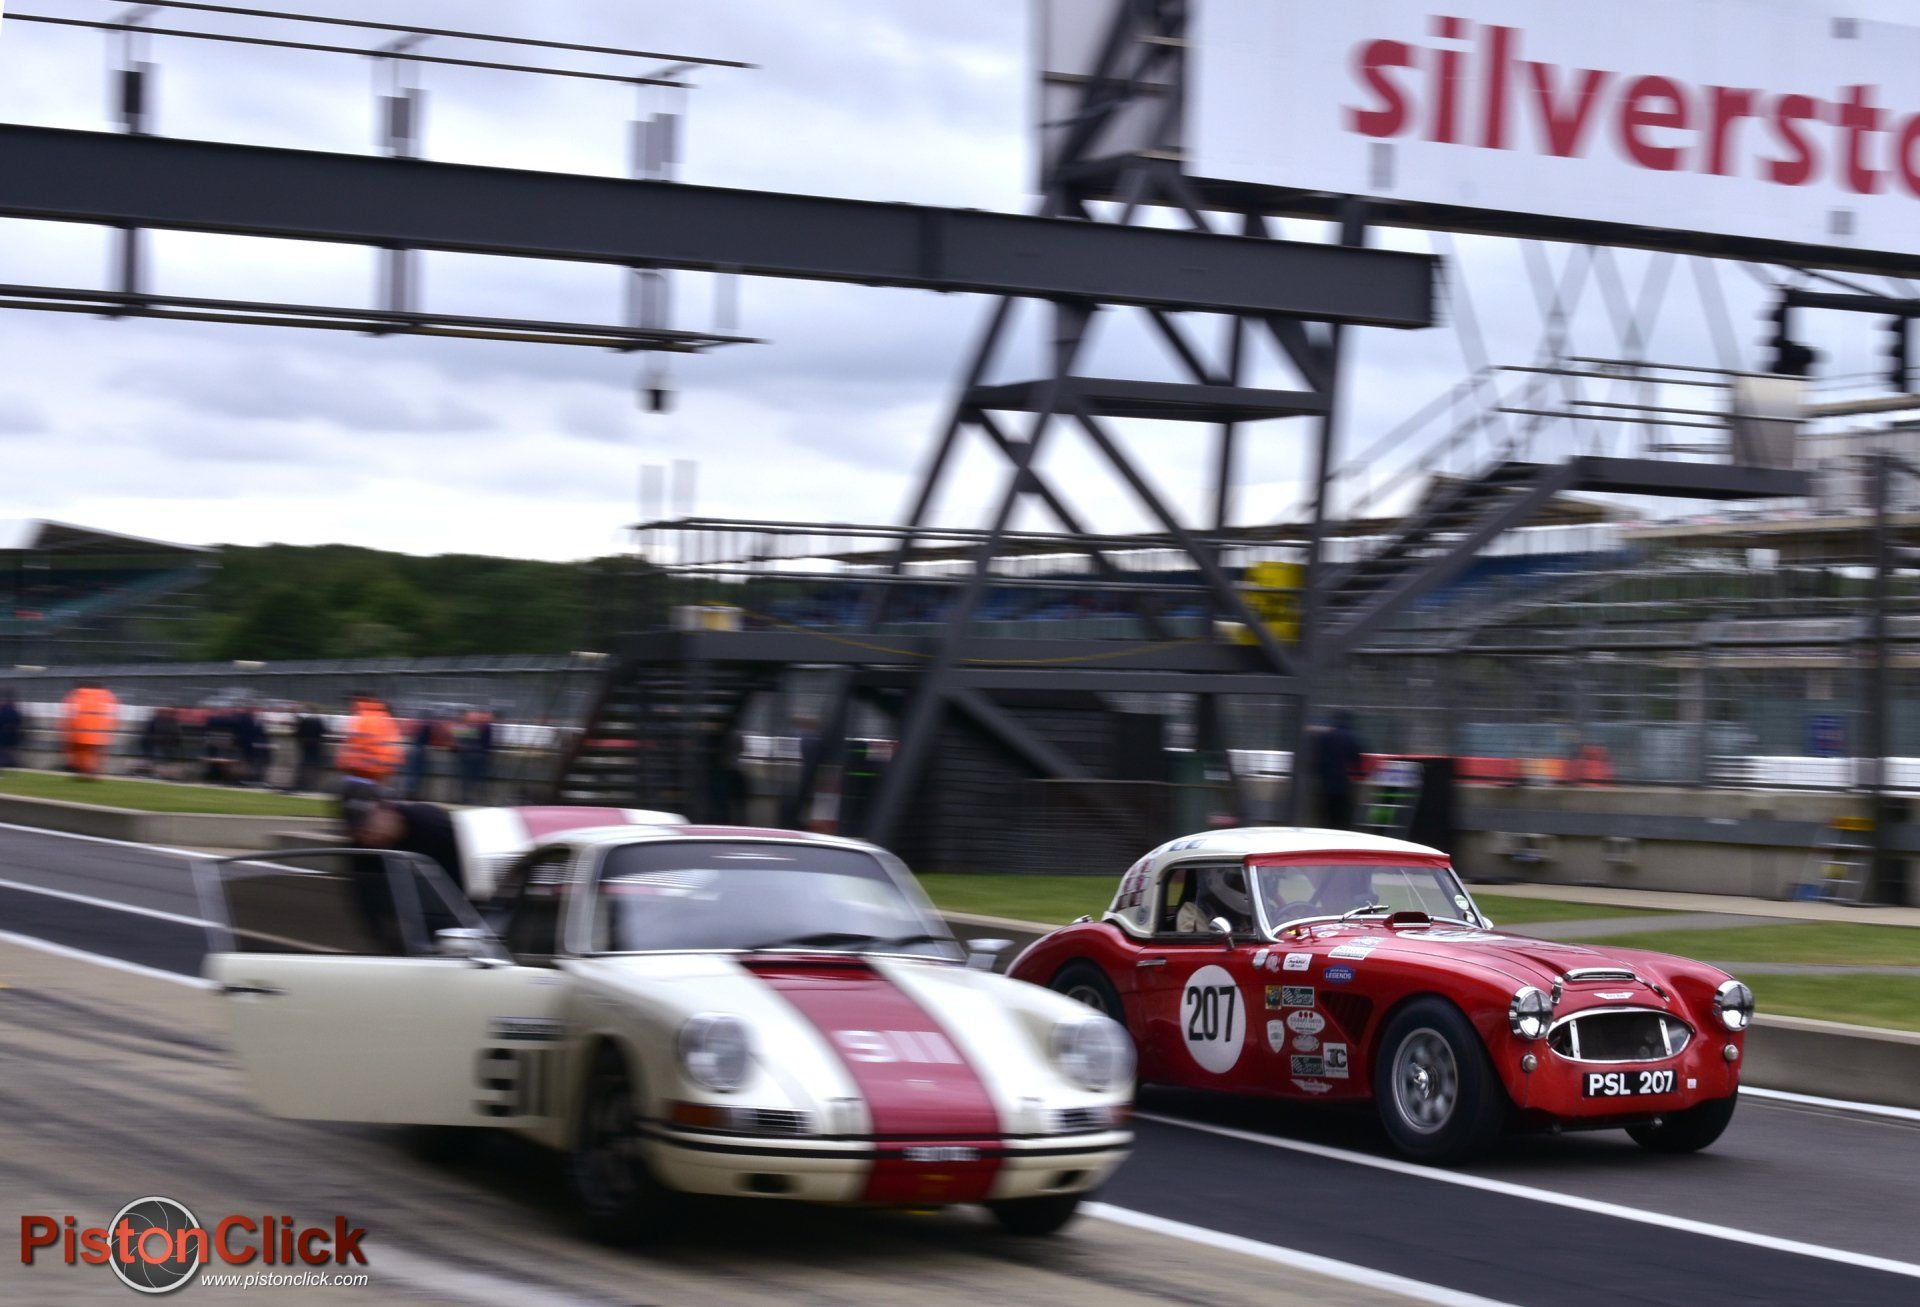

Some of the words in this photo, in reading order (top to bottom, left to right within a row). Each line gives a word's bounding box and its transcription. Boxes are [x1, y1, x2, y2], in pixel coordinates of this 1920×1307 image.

[1187, 986, 1235, 1042] 207
[1589, 1073, 1630, 1096] PSL
[1639, 1070, 1673, 1094] 207
